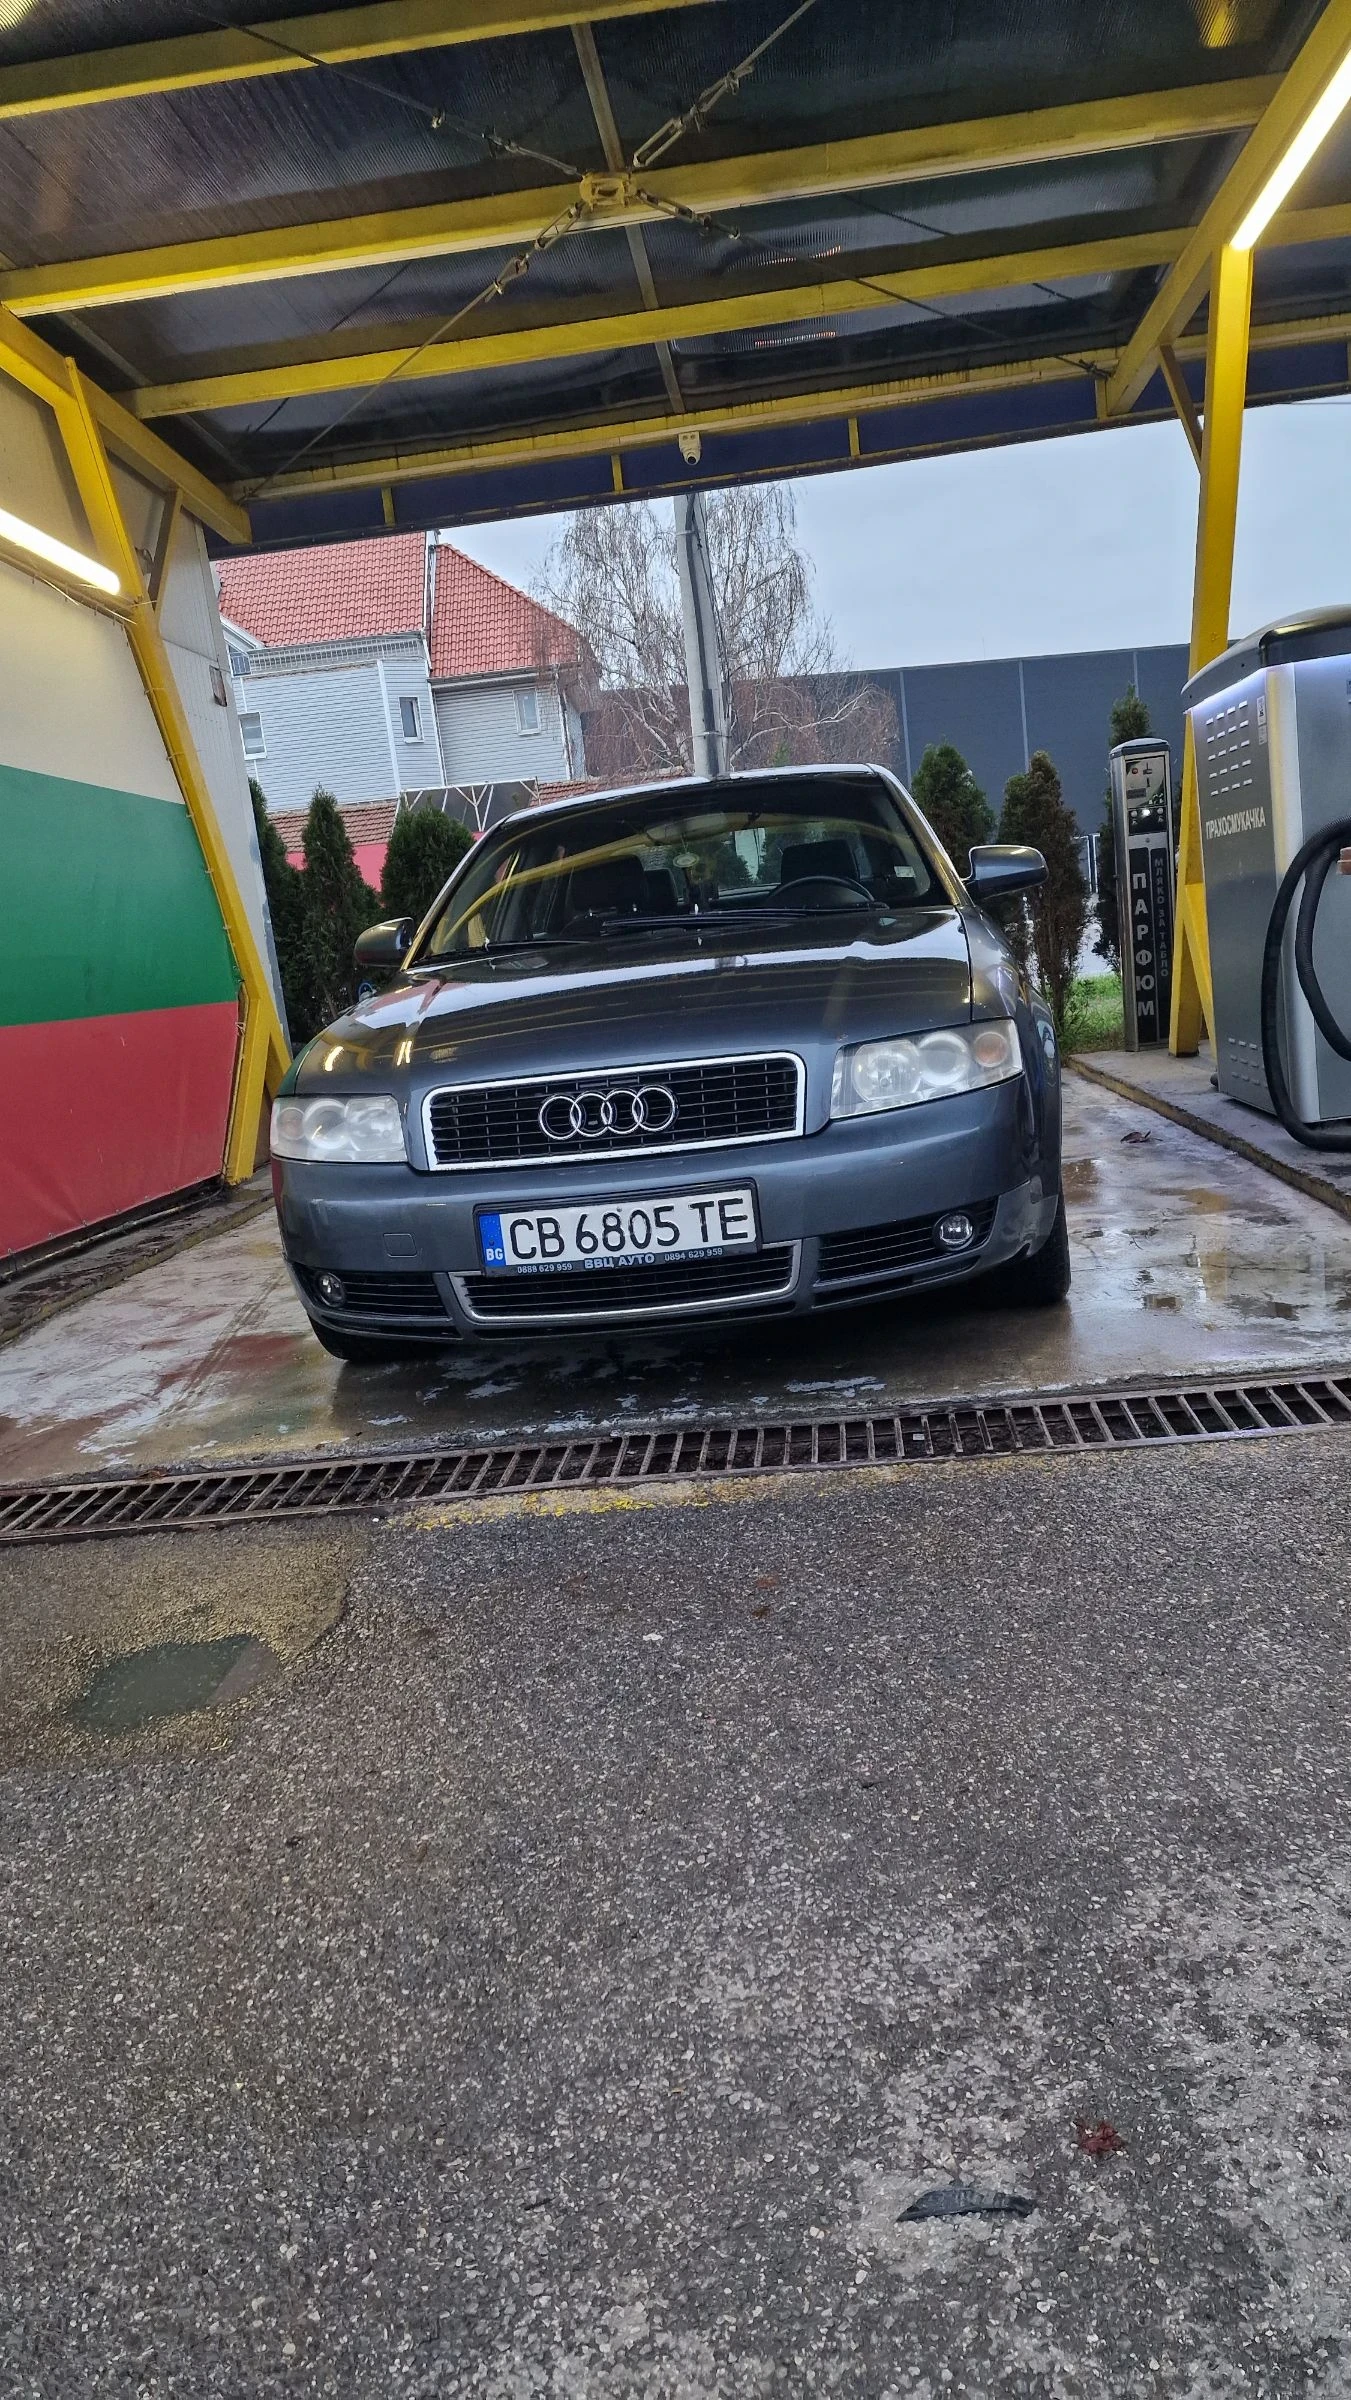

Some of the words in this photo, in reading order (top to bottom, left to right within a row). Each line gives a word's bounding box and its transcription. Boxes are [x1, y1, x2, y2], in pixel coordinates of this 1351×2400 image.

[1205, 806, 1266, 840] ПРАХОСМУКАЧКА
[1132, 872, 1155, 1017] ПАРФЮМ
[509, 1217, 565, 1260] CB
[575, 1205, 680, 1254] 6805
[689, 1197, 749, 1243] TE
[485, 1248, 504, 1261] BG
[517, 1264, 538, 1274] 0888
[539, 1263, 555, 1273] 629
[556, 1262, 573, 1272] 959
[618, 1253, 656, 1267] АУТО
[664, 1252, 686, 1262] 0894
[688, 1250, 705, 1259] 629
[706, 1247, 723, 1257] 959
